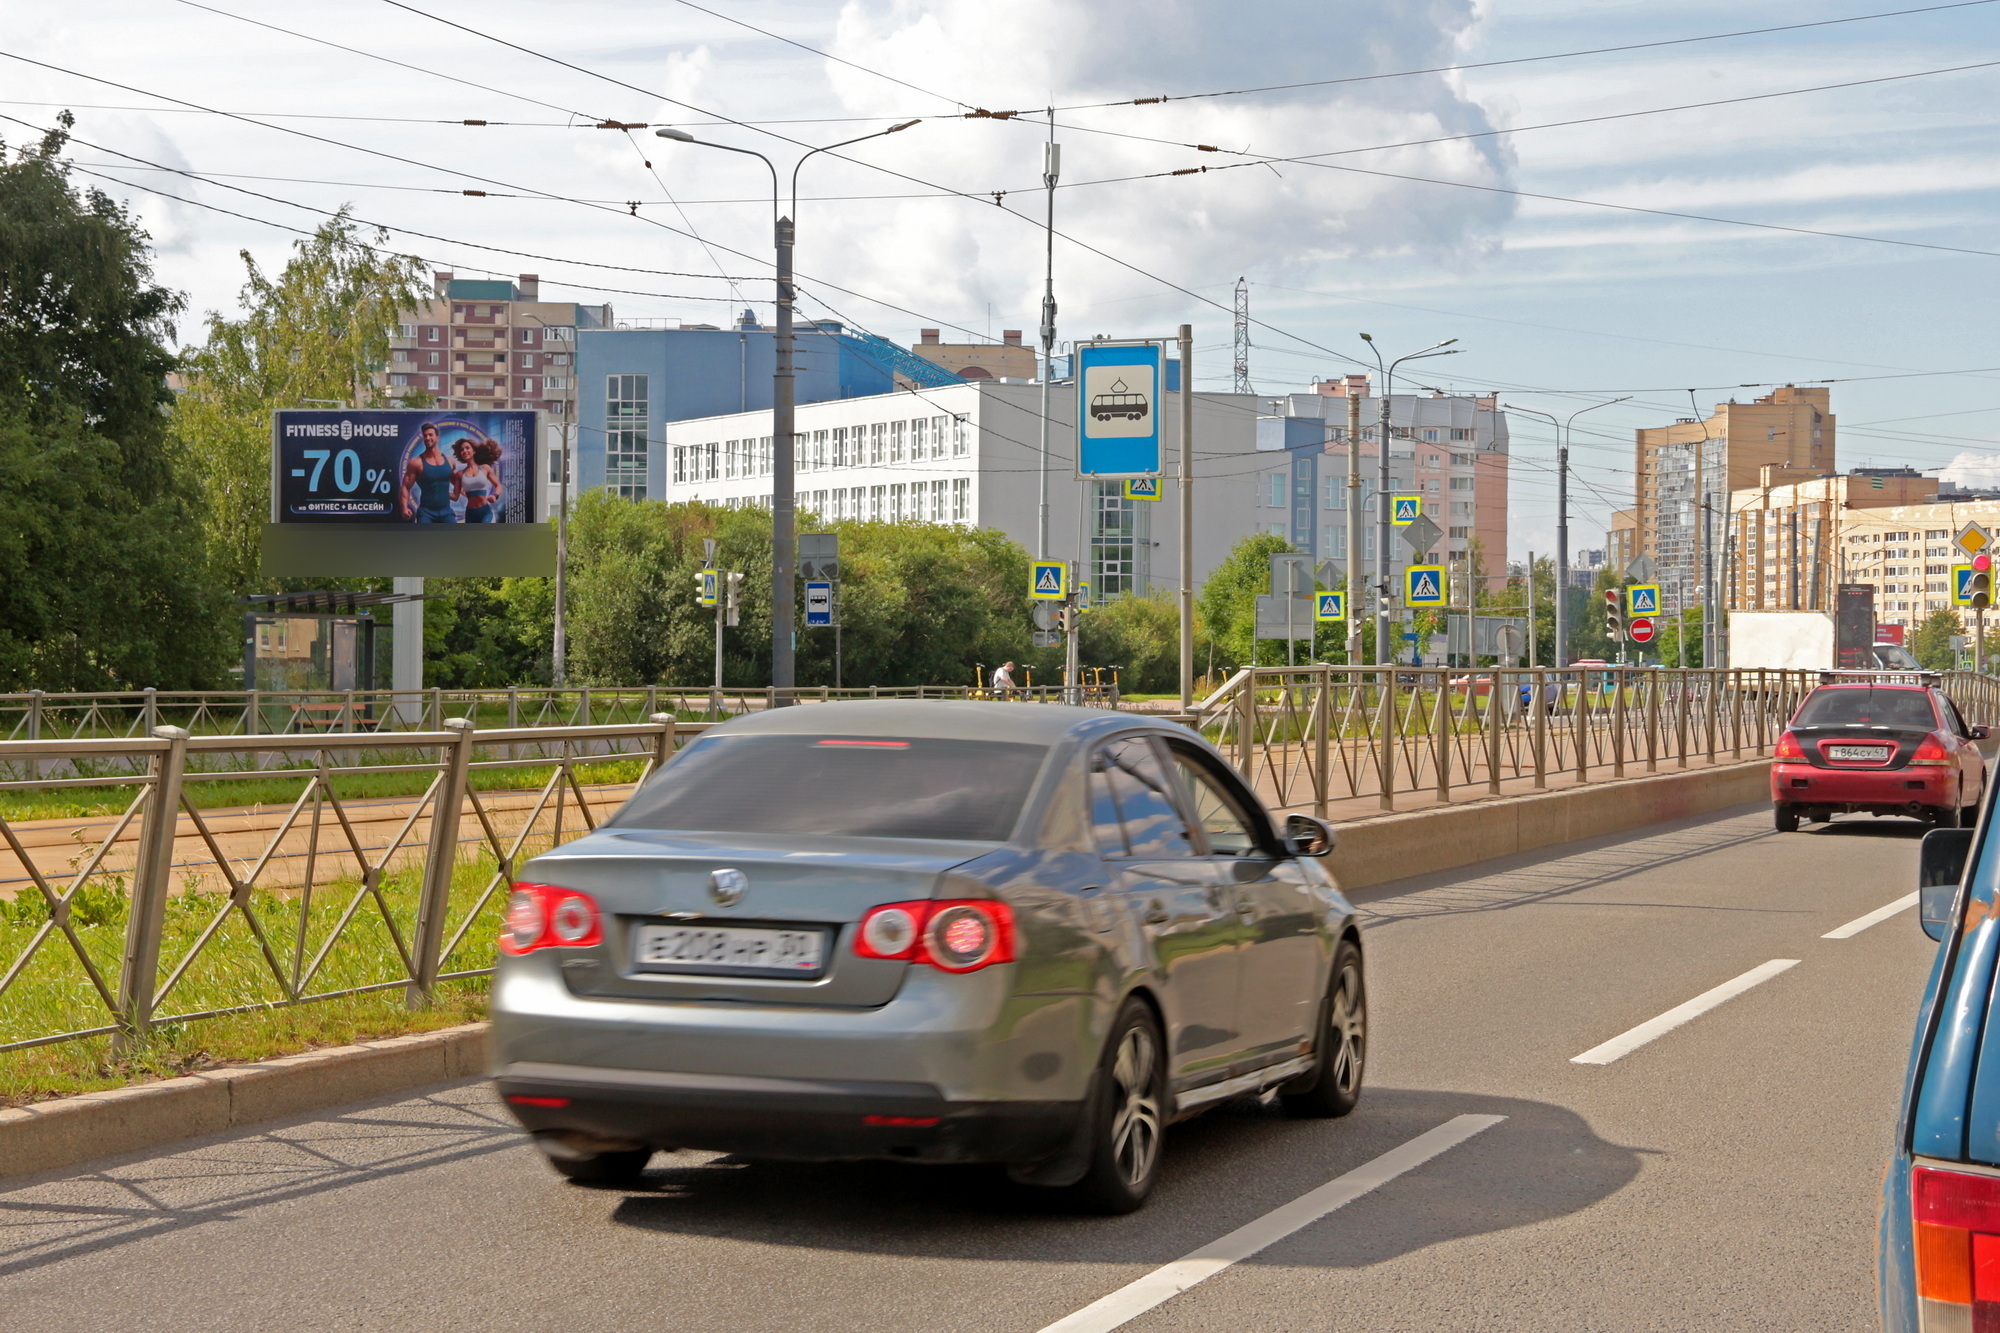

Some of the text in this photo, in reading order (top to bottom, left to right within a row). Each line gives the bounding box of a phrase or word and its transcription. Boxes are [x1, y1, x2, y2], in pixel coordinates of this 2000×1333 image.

[286, 424, 399, 437] FITNESS HOUSE
[308, 503, 340, 511] ФИТНЕС
[347, 502, 384, 511] БАССЕЙН
